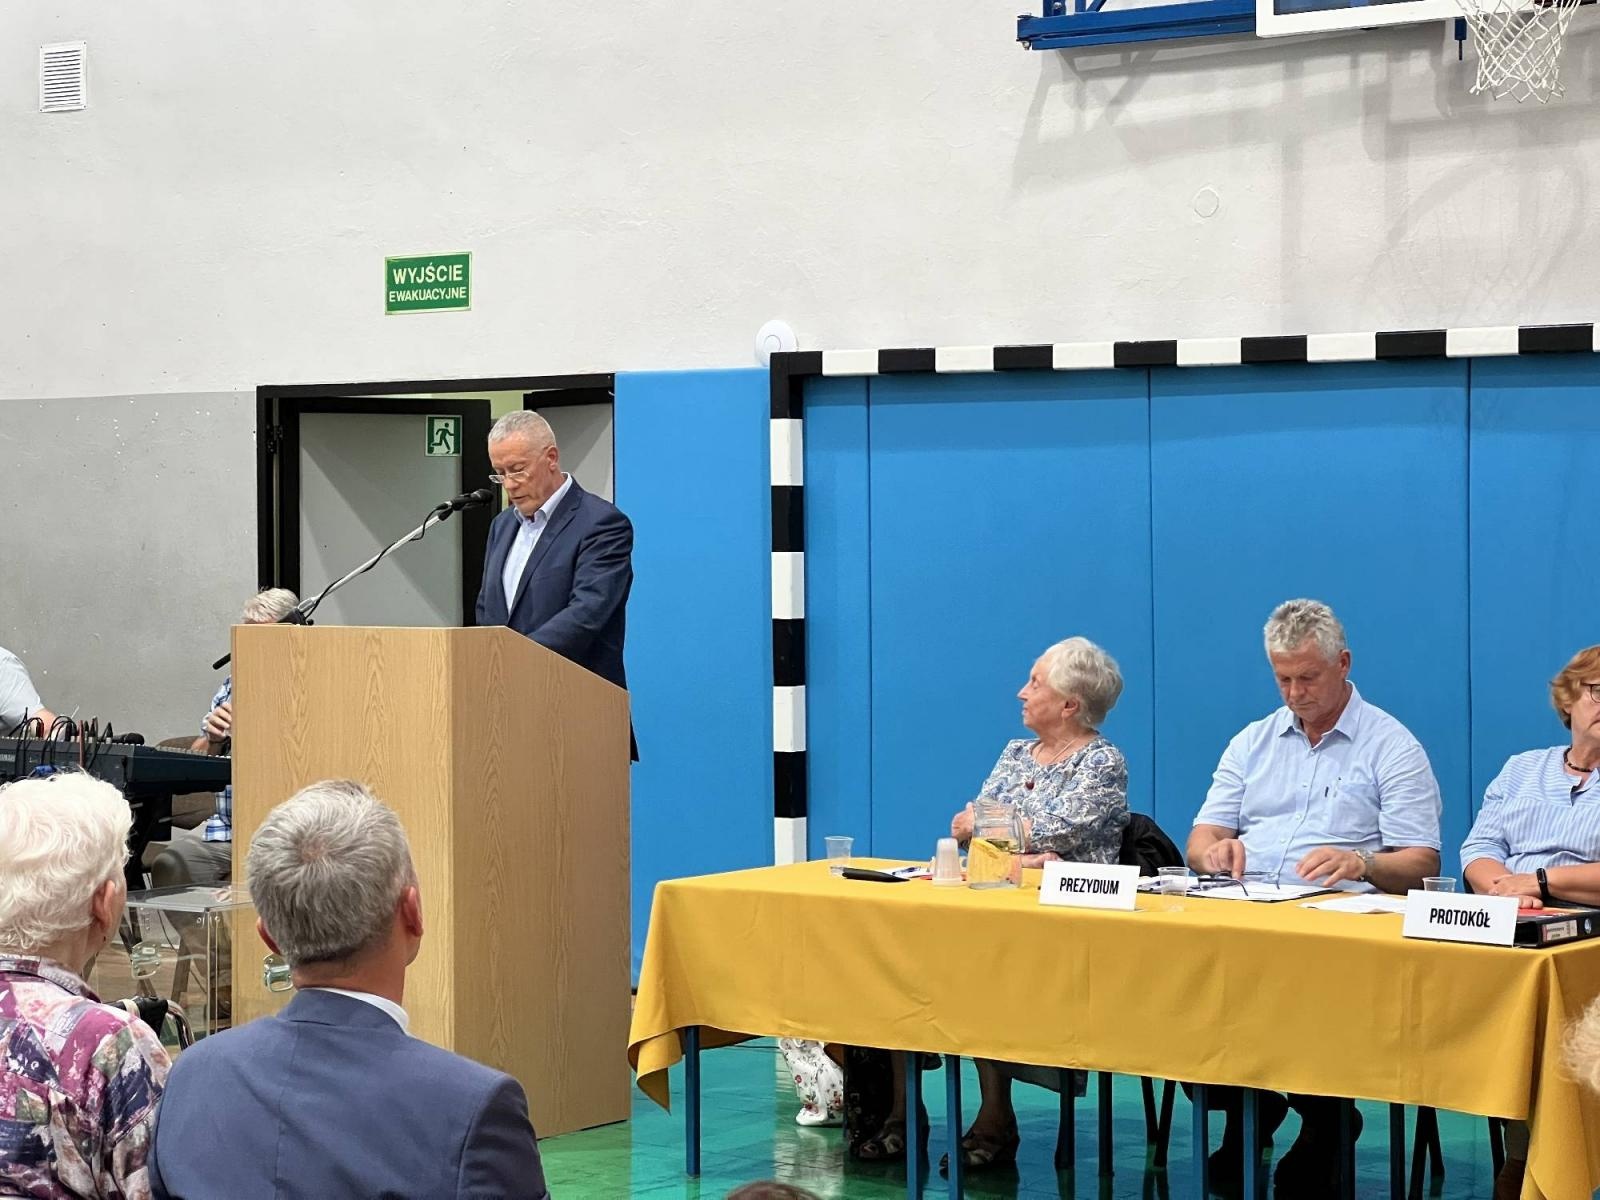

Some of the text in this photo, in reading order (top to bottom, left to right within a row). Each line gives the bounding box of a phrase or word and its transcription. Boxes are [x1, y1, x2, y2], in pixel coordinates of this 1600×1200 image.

[392, 262, 463, 284] WYJŚCIE
[389, 286, 467, 302] EWAKUACYJNE
[1059, 877, 1120, 895] PREZYDIUM
[1429, 907, 1491, 928] PROTOKÓŁ
